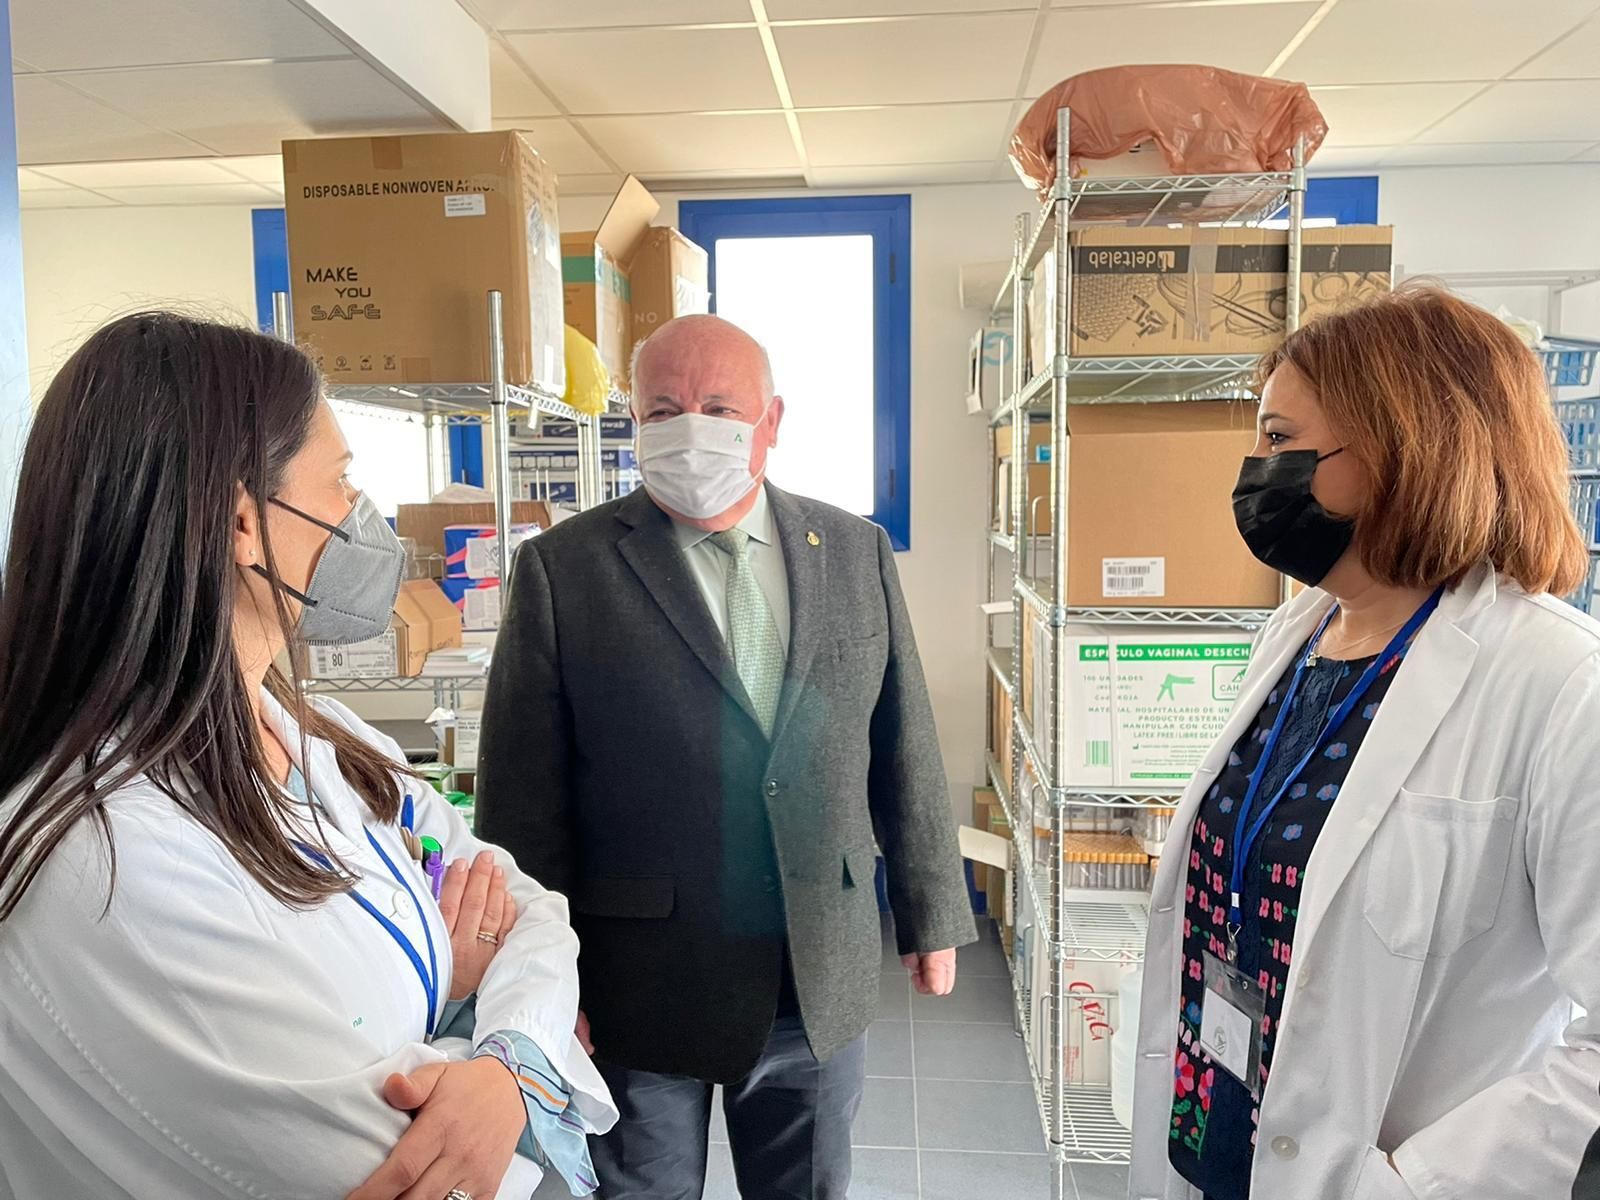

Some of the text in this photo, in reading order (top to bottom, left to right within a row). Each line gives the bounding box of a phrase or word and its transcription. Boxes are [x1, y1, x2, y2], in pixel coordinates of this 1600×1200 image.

[303, 182, 379, 199] DISPOSABLE
[382, 179, 453, 195] NONWOVEN
[1088, 250, 1157, 269] deltalab
[306, 266, 358, 283] MAKE
[335, 287, 371, 299] YOU
[310, 303, 381, 321] SAFE
[634, 311, 658, 324] NO
[331, 653, 343, 667] 80
[1084, 648, 1144, 658] ESPCULO
[1147, 647, 1200, 657] VAGINAL
